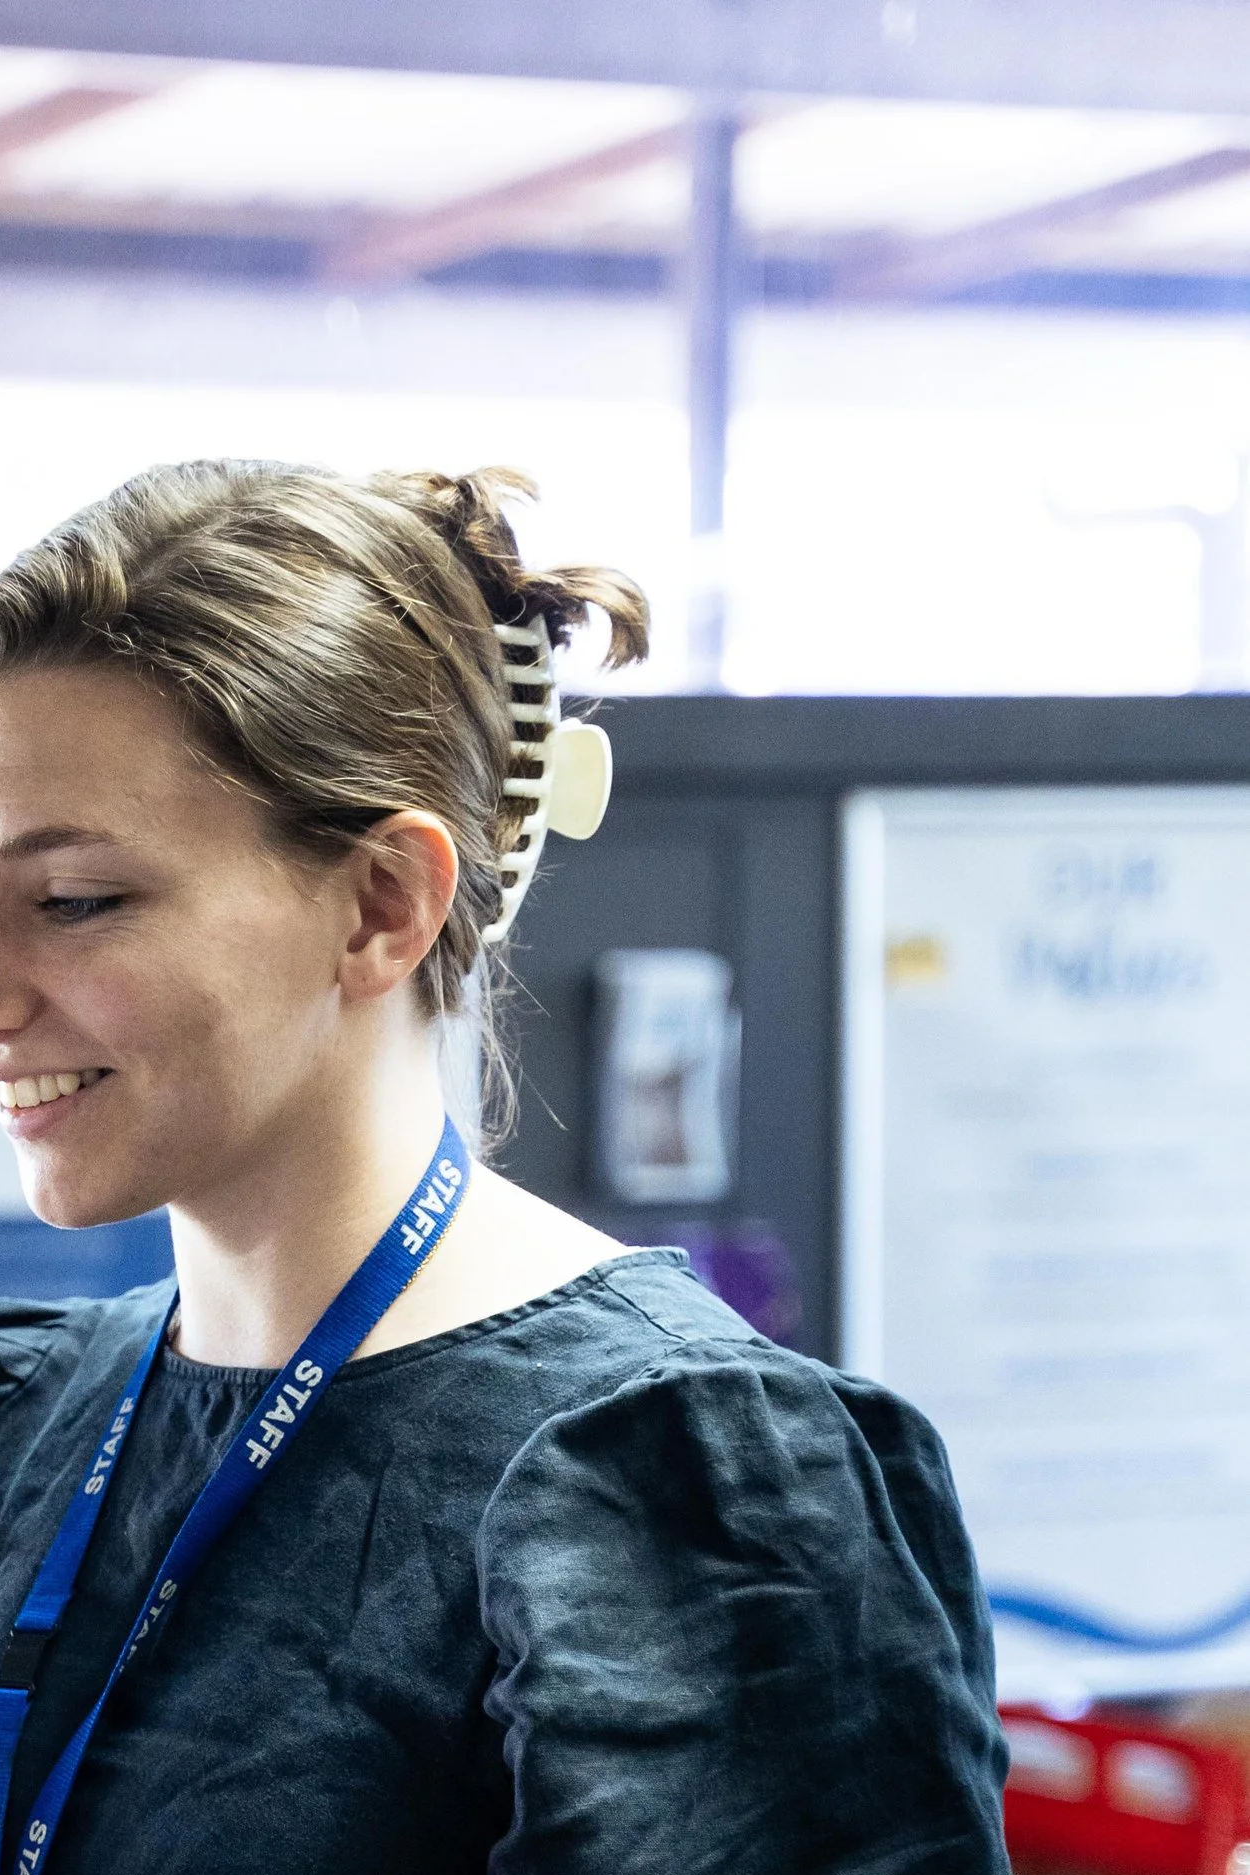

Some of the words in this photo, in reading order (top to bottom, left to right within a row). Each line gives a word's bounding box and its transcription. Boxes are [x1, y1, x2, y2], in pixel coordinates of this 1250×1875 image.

[400, 1158, 463, 1256] STAFF
[84, 1396, 136, 1495] STAFF
[245, 1359, 323, 1470] STAFF
